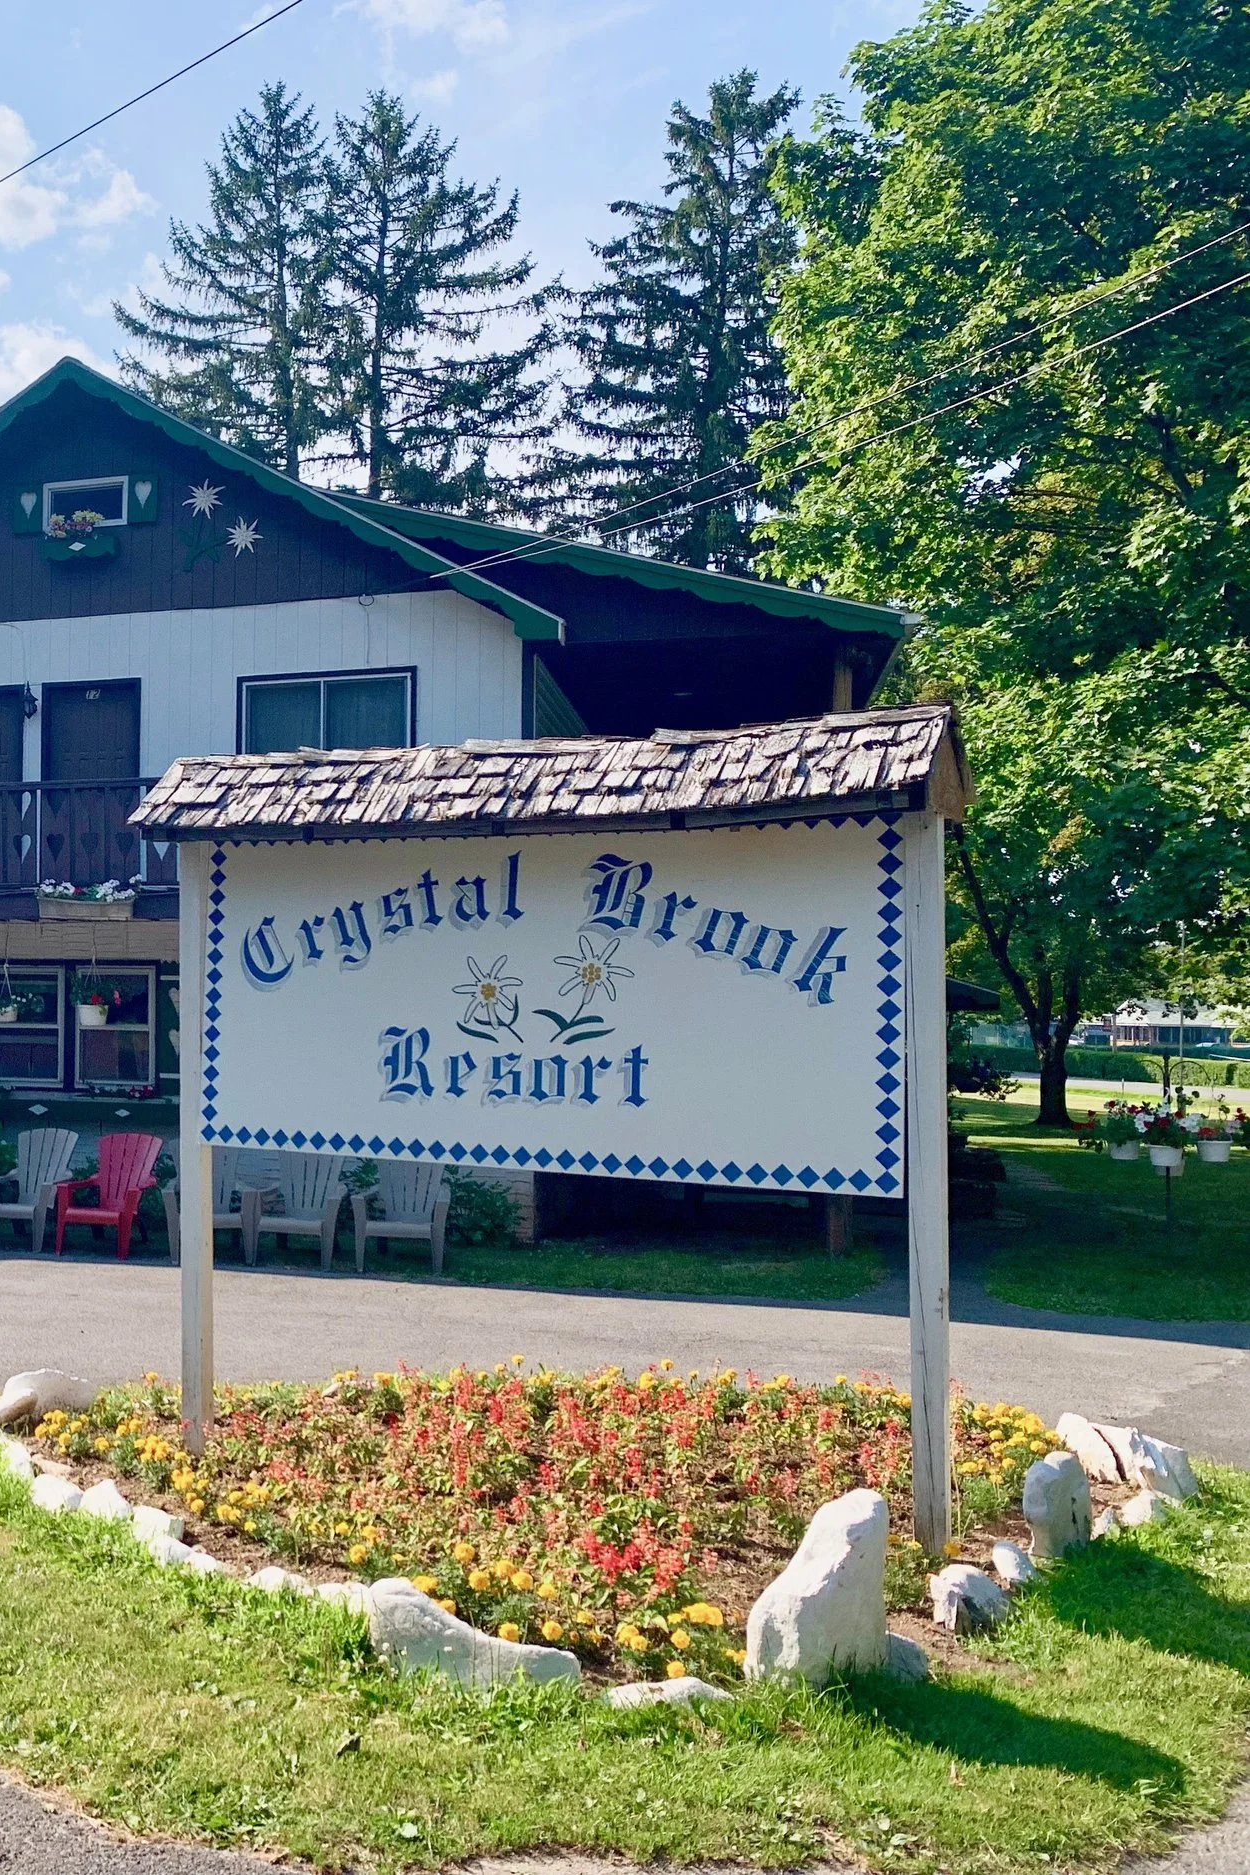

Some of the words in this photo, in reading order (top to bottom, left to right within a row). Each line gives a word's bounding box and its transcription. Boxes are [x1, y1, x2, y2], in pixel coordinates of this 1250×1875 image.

[86, 689, 100, 699] 12
[241, 850, 525, 988] Crystal
[586, 853, 848, 1006] Brook
[381, 1025, 648, 1107] Resort
